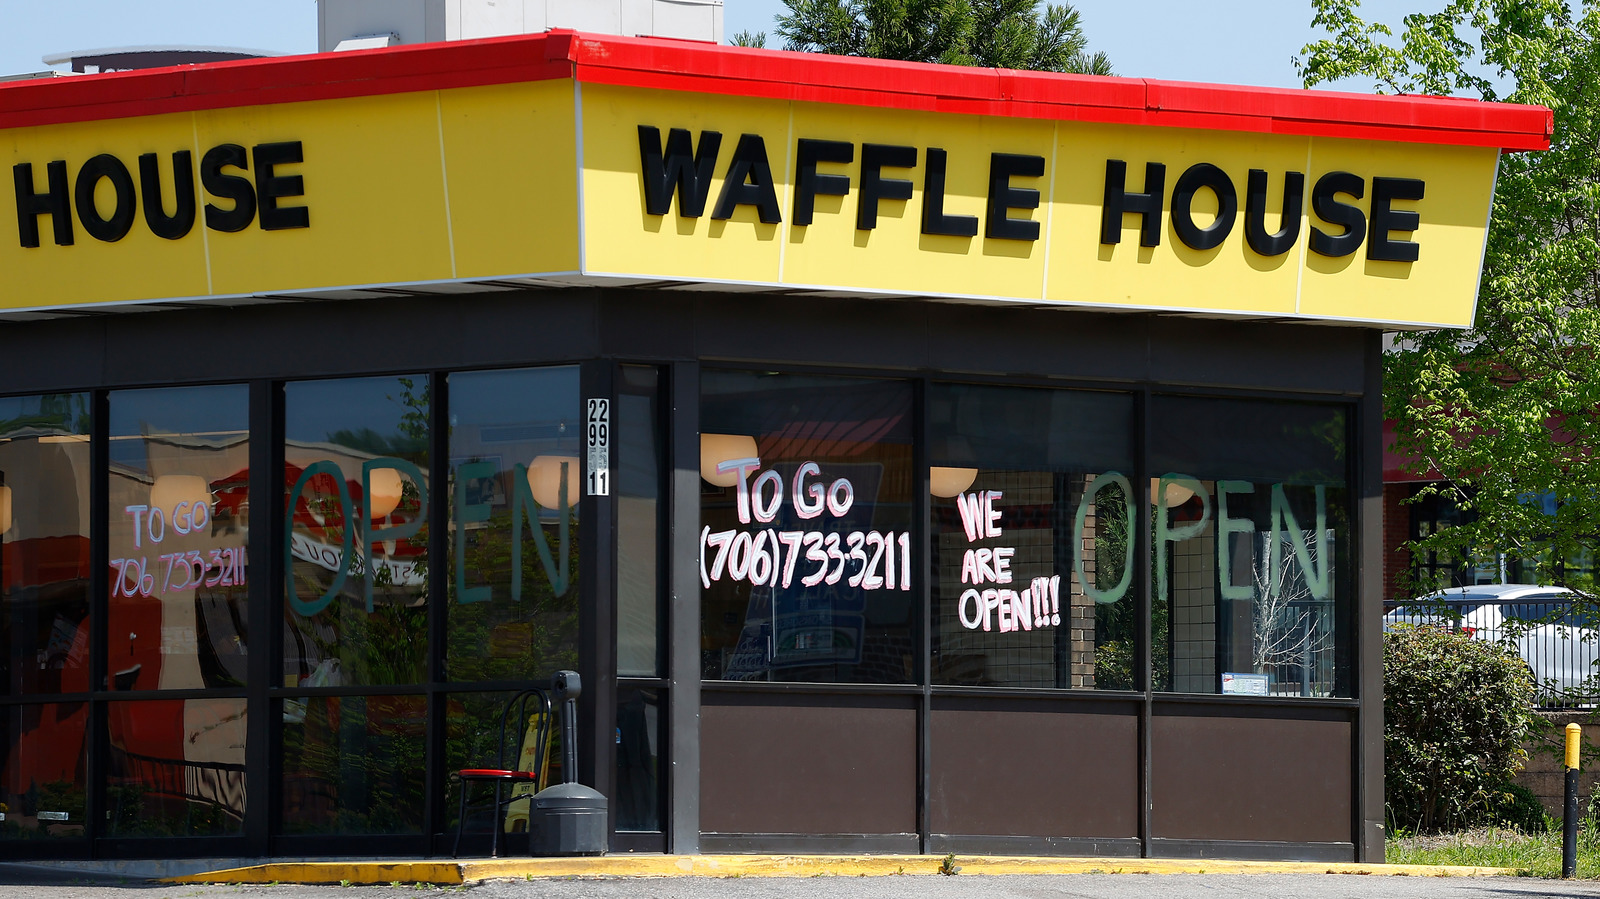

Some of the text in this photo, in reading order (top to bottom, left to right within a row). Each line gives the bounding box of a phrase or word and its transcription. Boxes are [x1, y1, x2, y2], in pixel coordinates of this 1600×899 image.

[13, 141, 309, 248] HOUSE
[637, 125, 1425, 263] WAFFLE HOUSE
[125, 501, 210, 550] TO GO
[285, 457, 569, 616] OPEN
[957, 491, 1003, 543] WE
[1075, 471, 1329, 603] OPEN
[109, 556, 154, 597] 706
[961, 547, 1015, 585] ARE
[958, 575, 1061, 633] OPEN!!!
